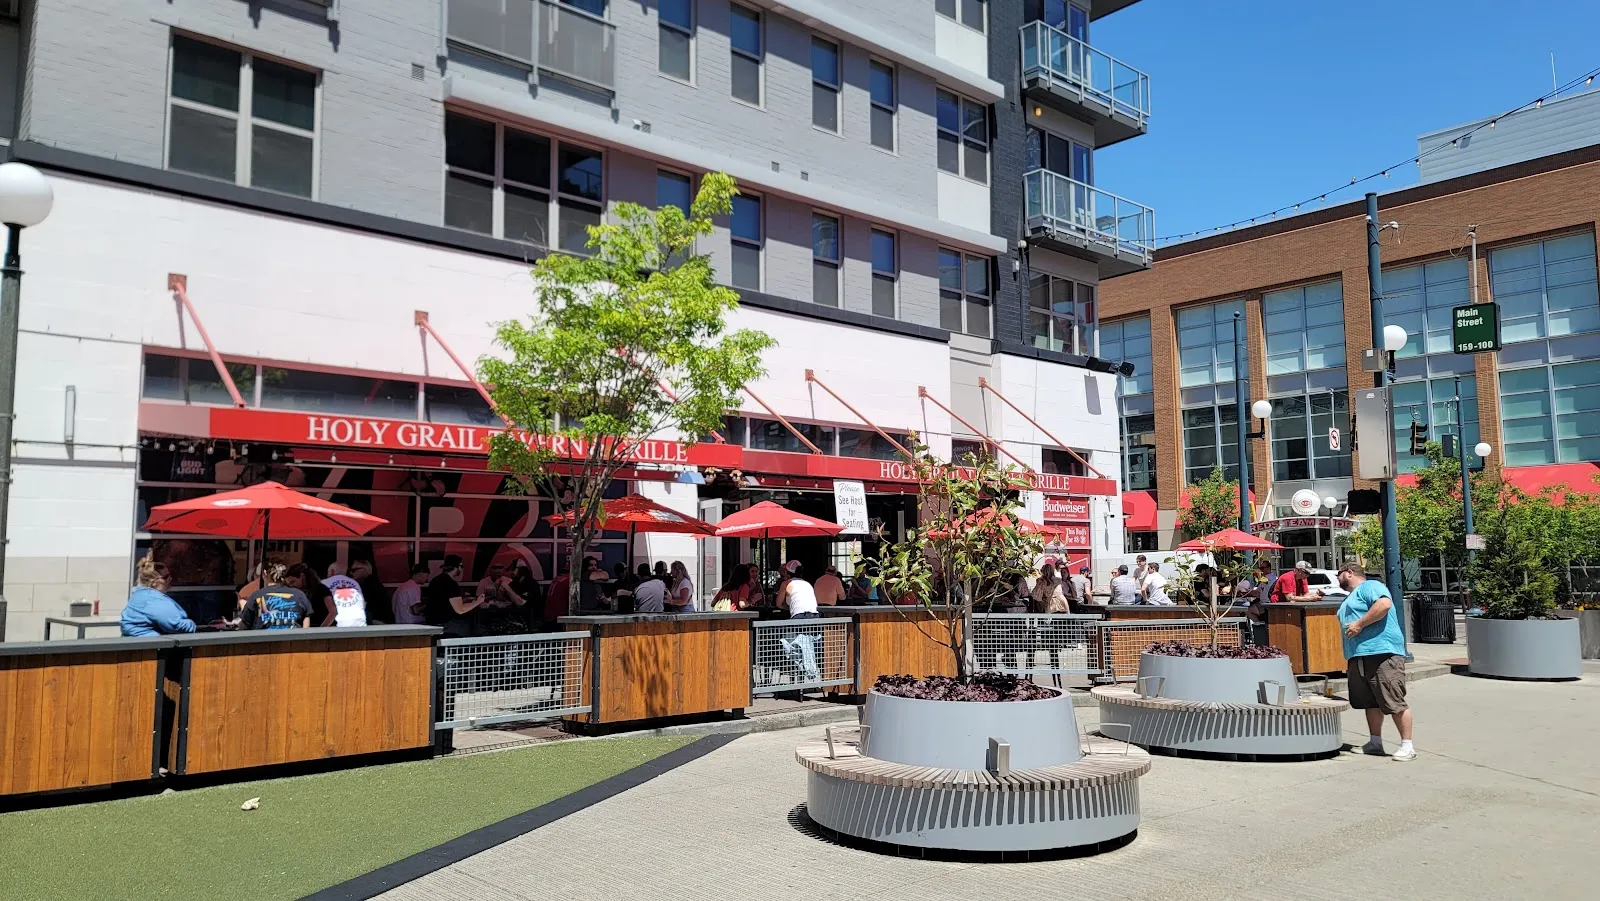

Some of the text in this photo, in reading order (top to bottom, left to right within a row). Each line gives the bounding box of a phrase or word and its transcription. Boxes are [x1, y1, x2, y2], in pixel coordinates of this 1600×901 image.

[1457, 308, 1478, 318] Main
[1457, 317, 1483, 327] Street
[1458, 340, 1493, 351] 159-100
[307, 416, 391, 444] HOLY
[396, 423, 483, 450] GRAIL
[180, 460, 202, 468] BUD
[177, 467, 206, 475] LIGHT
[838, 483, 860, 493] Please
[838, 495, 864, 505] See Host
[1043, 500, 1086, 513] Budweiser
[848, 508, 856, 517] for
[842, 518, 864, 530] Seating
[1250, 520, 1279, 533] REDS
[1283, 518, 1316, 528] TEAM
